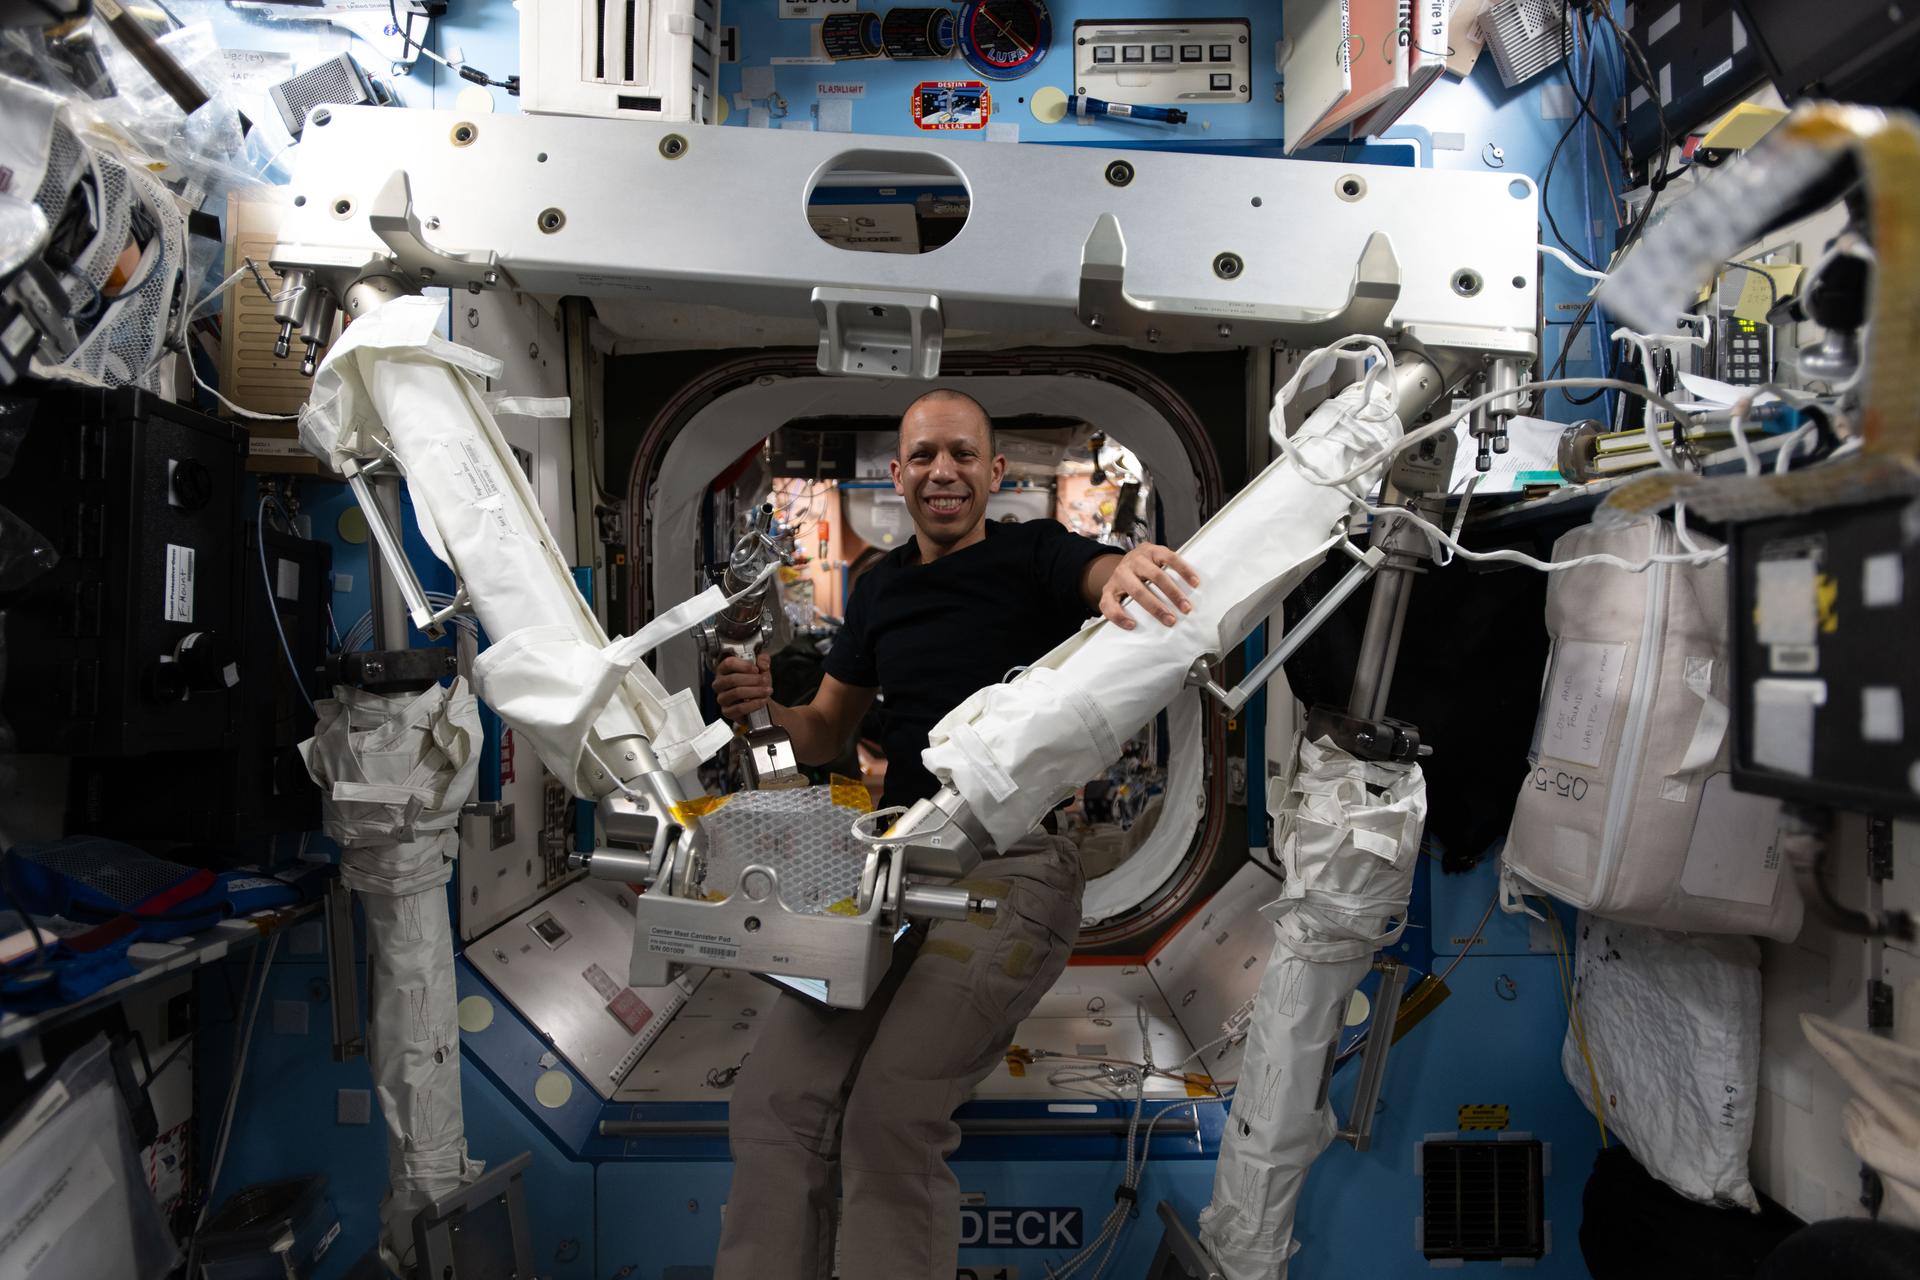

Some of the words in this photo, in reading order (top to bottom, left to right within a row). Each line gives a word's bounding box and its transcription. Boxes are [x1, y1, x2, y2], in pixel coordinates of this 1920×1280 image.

[1399, 0, 1412, 46] ING
[1567, 694, 1583, 727] FOUND
[1554, 713, 1568, 740] LOST
[651, 927, 673, 936] Center
[690, 932, 717, 941] Canister
[718, 935, 732, 943] Pad
[772, 955, 783, 963] Set
[959, 1211, 1079, 1245] DECK
